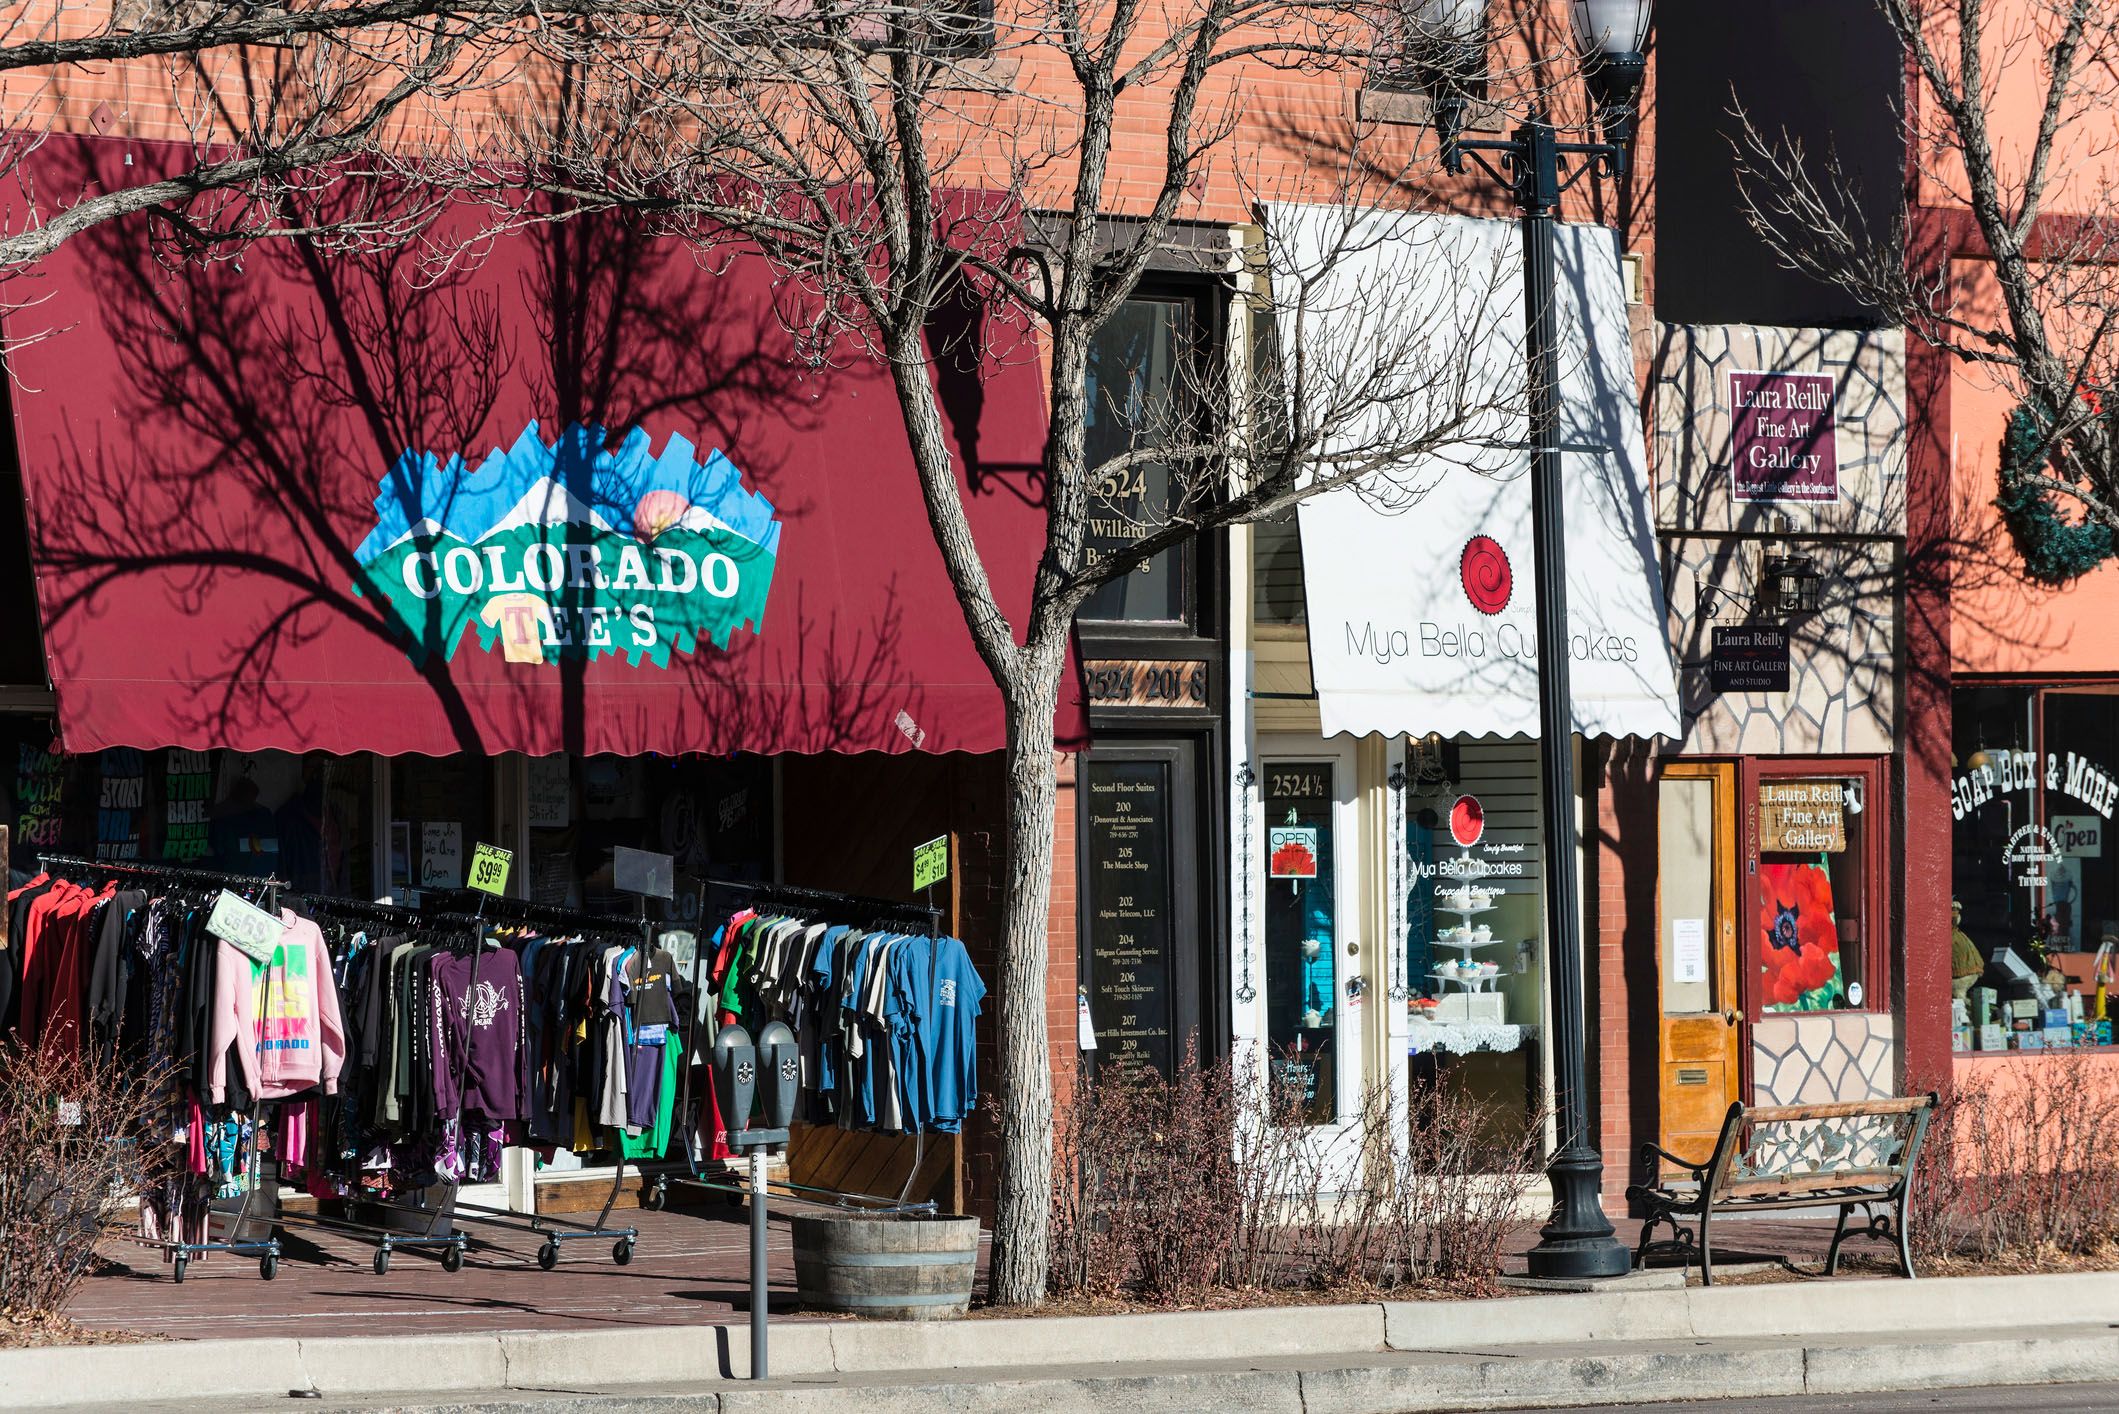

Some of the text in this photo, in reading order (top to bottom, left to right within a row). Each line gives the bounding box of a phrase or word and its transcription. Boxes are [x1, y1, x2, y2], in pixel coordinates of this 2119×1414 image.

[1734, 380, 1830, 416] Laura Reilly
[1757, 416, 1810, 438] Fine Art
[1749, 445, 1821, 474] Gallery
[1090, 518, 1146, 539] Willard
[401, 543, 739, 599] COLORADO
[504, 603, 658, 647] TEE'S
[1346, 621, 1638, 664] Mya Bella Cuakes
[1716, 632, 1785, 649] Laura Reilly
[1714, 660, 1787, 671] FINE ART GALLERY
[1092, 782, 1155, 792] Second Floor Suites
[1272, 775, 1310, 796] 2524
[1951, 749, 2118, 821] SOAP BOX & MORE
[100, 777, 144, 808] STORY
[1768, 785, 1850, 806] Laura Reilly
[1115, 802, 1131, 812] 200
[1783, 808, 1839, 824] Fine Art
[1271, 832, 1315, 846] OPEN
[1786, 829, 1836, 849] Gallery
[424, 841, 437, 855] We
[477, 844, 512, 861] SALE SALE
[1118, 848, 1132, 858] 205
[423, 859, 449, 886] Open
[1103, 861, 1148, 871] The Muscle Shop
[1412, 860, 1522, 878] Mya Bella Cupcakes
[2026, 864, 2039, 875] and
[1470, 885, 1505, 899] Boutique
[1119, 896, 1133, 907] 202
[1099, 910, 1117, 919] Alpine
[1144, 909, 1155, 917] LLC
[1119, 934, 1134, 945] 204
[1120, 972, 1135, 982] 206
[1101, 985, 1112, 993] Soft
[1113, 985, 1130, 993] Touch
[1122, 1015, 1136, 1026] 207
[1107, 1028, 1119, 1036] Hills
[1120, 1028, 1147, 1036] Investment
[1158, 1027, 1168, 1036] Inc.
[1122, 1039, 1137, 1050] 209
[787, 1058, 791, 1066] 2
[1136, 1051, 1150, 1059] Reiki
[782, 1070, 797, 1081] HOUR
